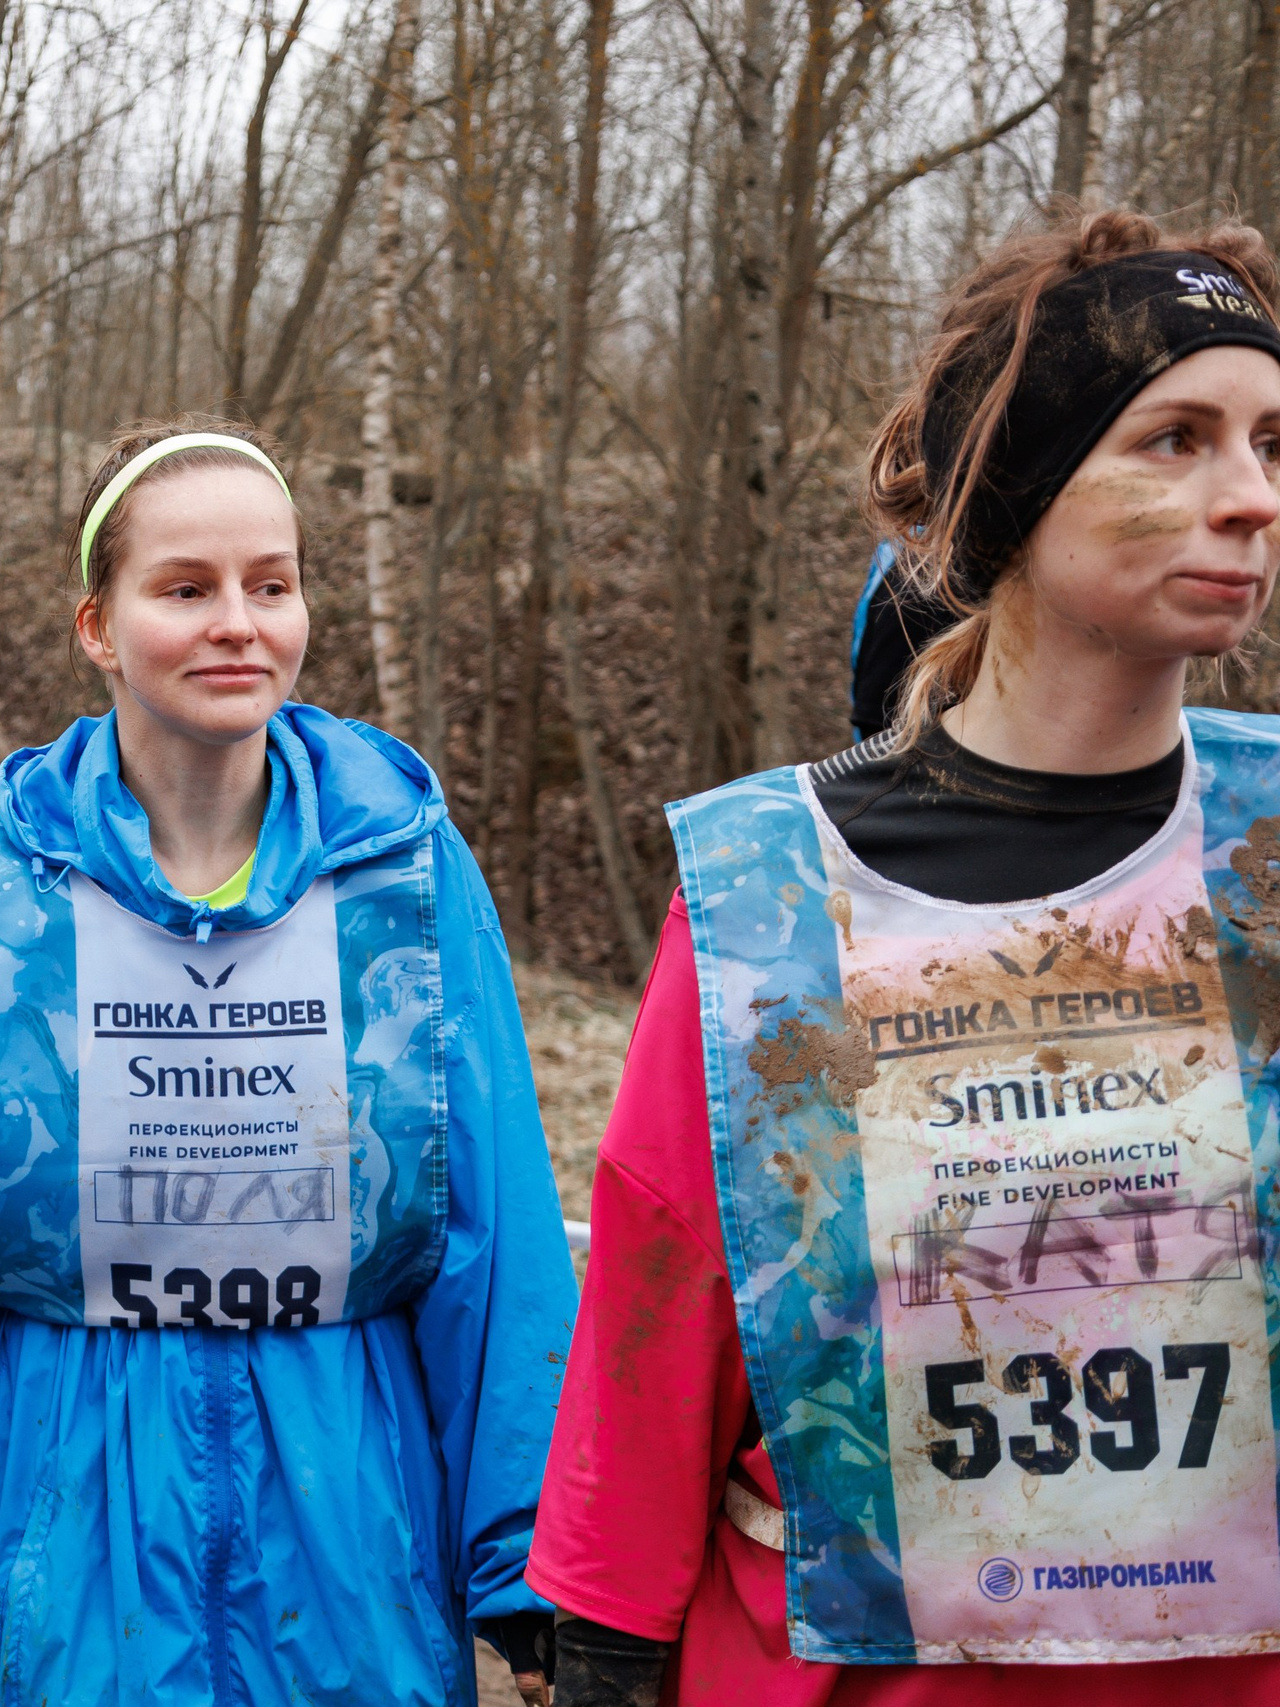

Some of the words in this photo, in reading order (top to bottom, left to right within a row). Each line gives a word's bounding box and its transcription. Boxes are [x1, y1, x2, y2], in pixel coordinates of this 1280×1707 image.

[94, 1002, 199, 1028] ГОНКА
[209, 999, 327, 1027] ГЕРОЕВ
[867, 999, 1018, 1050] ГОНКА
[1032, 981, 1204, 1028] ГЕРОЕВ
[128, 1055, 296, 1098] Sminex
[923, 1067, 1168, 1130] Sminex
[129, 1120, 299, 1138] ПЕРФЕКЦИОНИСТЫ
[129, 1145, 168, 1159] FINE
[176, 1143, 299, 1159] DEVELOPMENT
[933, 1140, 1179, 1180] ПЕРФЕКЦИОНИСТЫ
[118, 1163, 330, 1236] ПОЛЯ
[936, 1189, 991, 1211] FINE
[1003, 1171, 1181, 1206] DEVELOPMENT
[110, 1263, 322, 1331] 5398
[924, 1342, 1232, 1480] 5397
[1033, 1560, 1216, 1591] ГАЗПРОМБАНК
